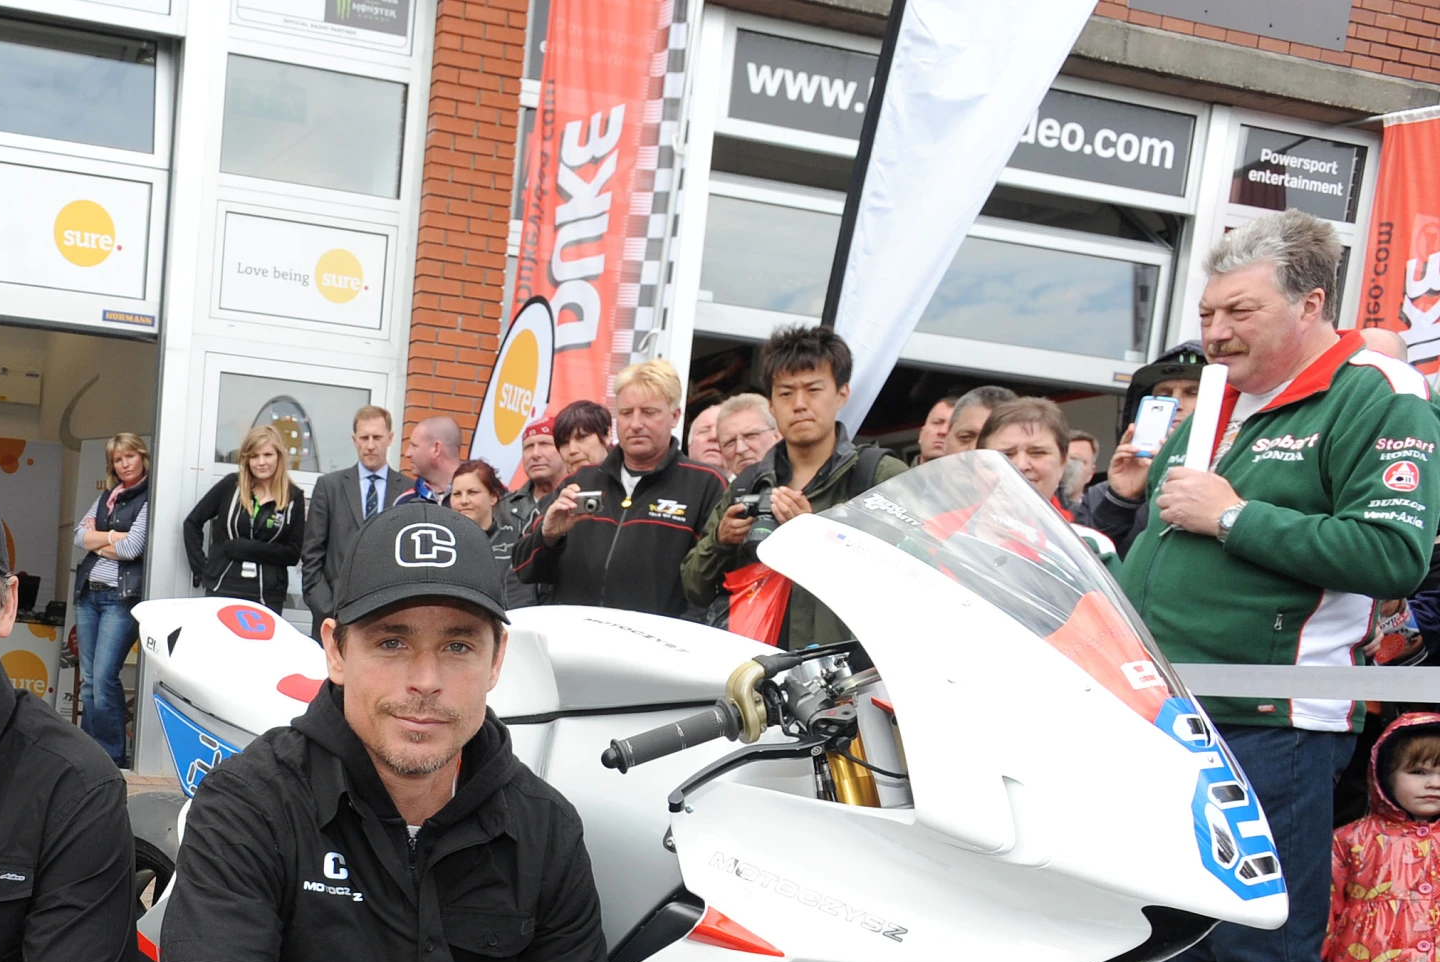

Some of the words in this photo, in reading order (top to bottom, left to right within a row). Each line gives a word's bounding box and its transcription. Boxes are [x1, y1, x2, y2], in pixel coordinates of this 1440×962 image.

[1260, 147, 1339, 176] Powersport
[1247, 169, 1344, 197] entertainment
[236, 261, 269, 278] Love
[273, 266, 310, 287] being
[1375, 436, 1436, 454] Stobart
[1379, 449, 1429, 462] HONDA
[1367, 498, 1427, 512] DUNLOP
[1363, 511, 1424, 530] Vent-Axia
[708, 850, 909, 944] MOTOCZYSZ
